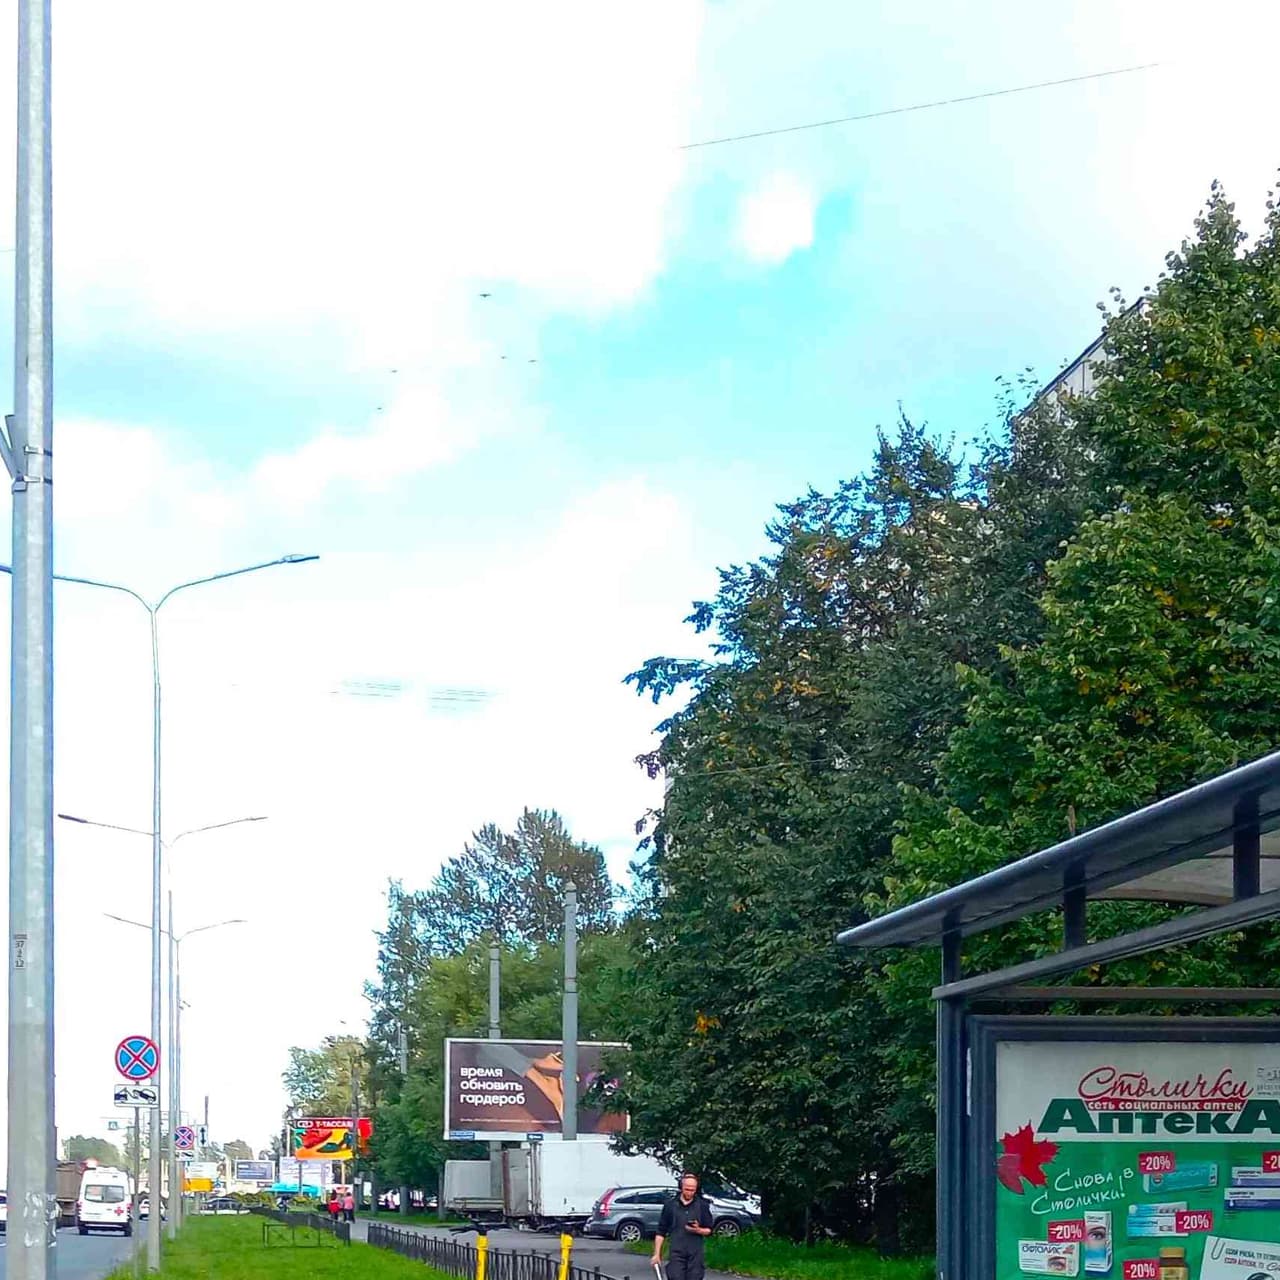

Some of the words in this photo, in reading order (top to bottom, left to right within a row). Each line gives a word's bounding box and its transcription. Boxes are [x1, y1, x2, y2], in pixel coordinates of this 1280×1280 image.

[460, 1067, 503, 1079] время
[460, 1078, 523, 1091] обновить
[1078, 1067, 1253, 1098] Столички
[460, 1092, 526, 1107] гардероб
[1088, 1101, 1115, 1111] сеть
[1118, 1101, 1201, 1113] социальных
[1203, 1101, 1242, 1111] аптек
[1139, 1155, 1171, 1171] -20%
[1177, 1214, 1210, 1230] -20%
[1049, 1223, 1083, 1240] -20%
[1125, 1263, 1156, 1279] -20%
